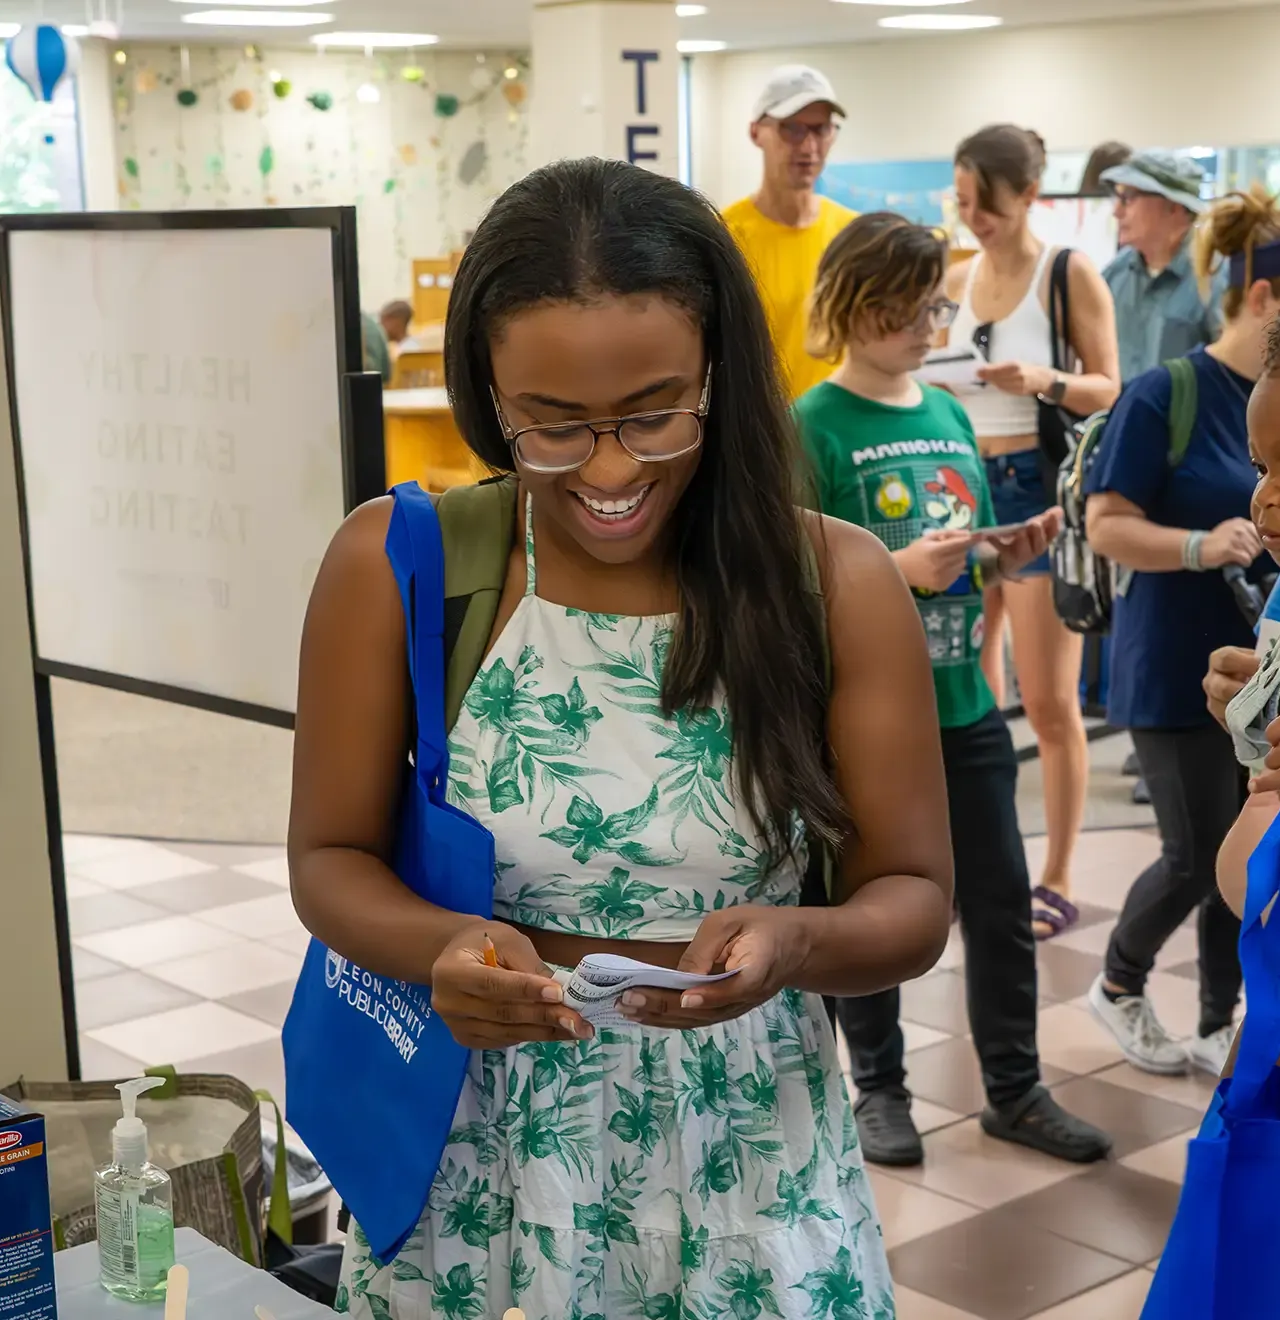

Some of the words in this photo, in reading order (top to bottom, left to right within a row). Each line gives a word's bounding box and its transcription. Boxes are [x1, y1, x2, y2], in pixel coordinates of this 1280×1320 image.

[342, 959, 382, 995] LEON
[385, 988, 425, 1039] COUNTY
[395, 980, 432, 1018] OLLINS
[6, 1148, 31, 1162] GRAIN
